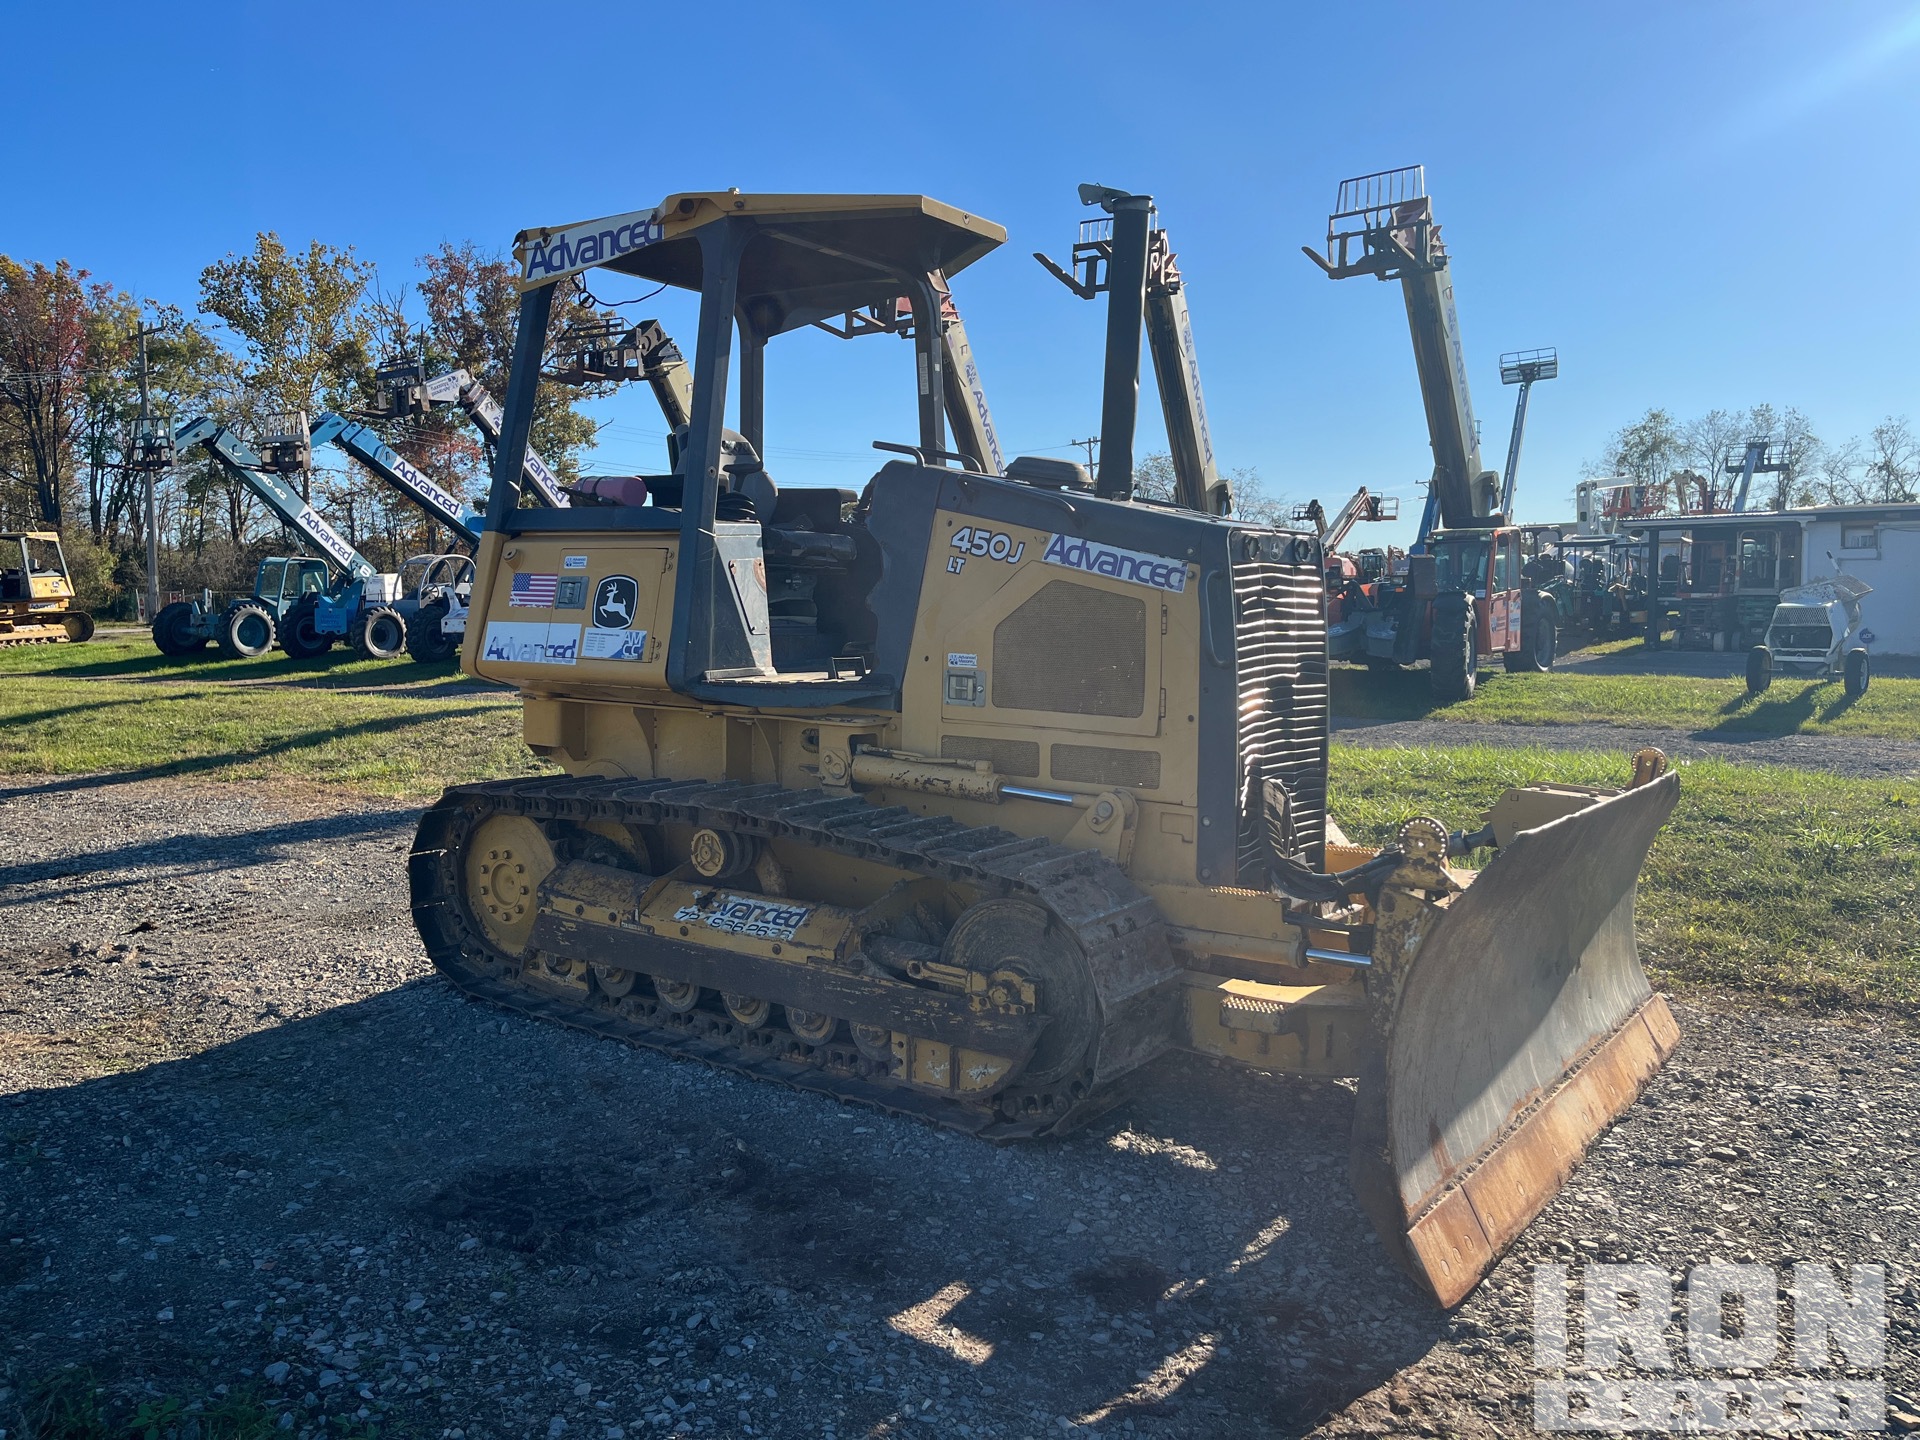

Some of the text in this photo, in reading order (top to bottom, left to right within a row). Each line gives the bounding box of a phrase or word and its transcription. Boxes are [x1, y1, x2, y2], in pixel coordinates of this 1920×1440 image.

[526, 217, 665, 279] Advanced
[1189, 359, 1213, 464] Advanced
[393, 461, 460, 516] Advanced
[525, 448, 567, 503] vanced
[300, 511, 353, 562] Advanced
[950, 525, 1026, 564] 450J
[1043, 534, 1186, 592] Advanced
[946, 556, 966, 575] LT
[486, 635, 577, 662] Advanced
